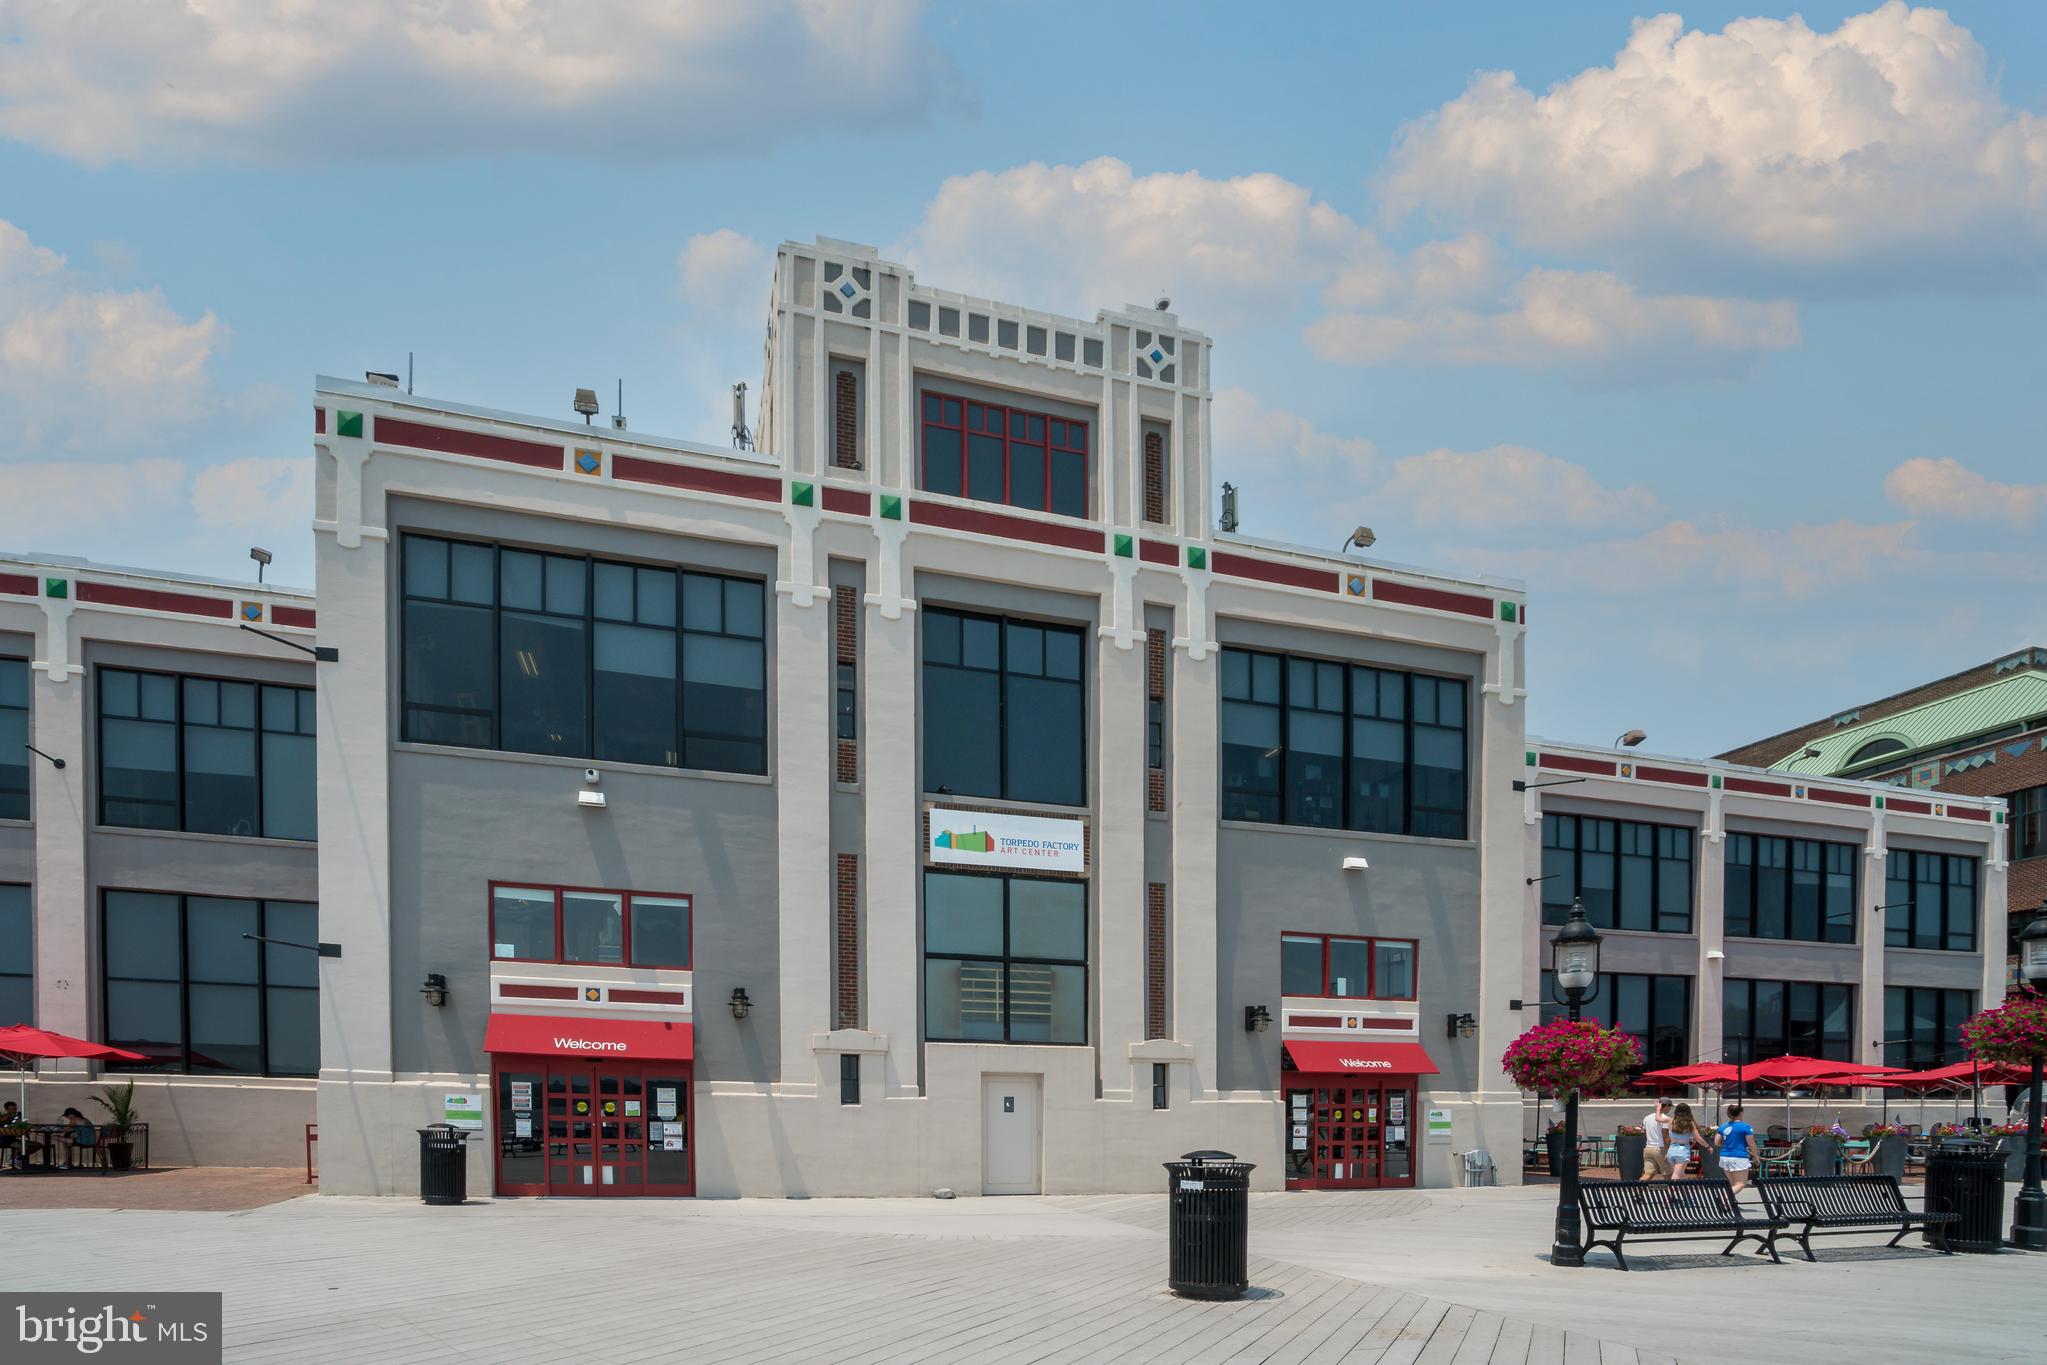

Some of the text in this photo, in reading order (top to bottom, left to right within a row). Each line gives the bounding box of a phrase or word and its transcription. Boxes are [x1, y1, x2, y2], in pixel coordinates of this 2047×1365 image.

[1000, 838, 1080, 851] TORPEDO FACTORY
[1000, 847, 1060, 857] ART CENTER
[553, 1037, 627, 1051] Welcome
[1339, 1058, 1392, 1068] Welcome
